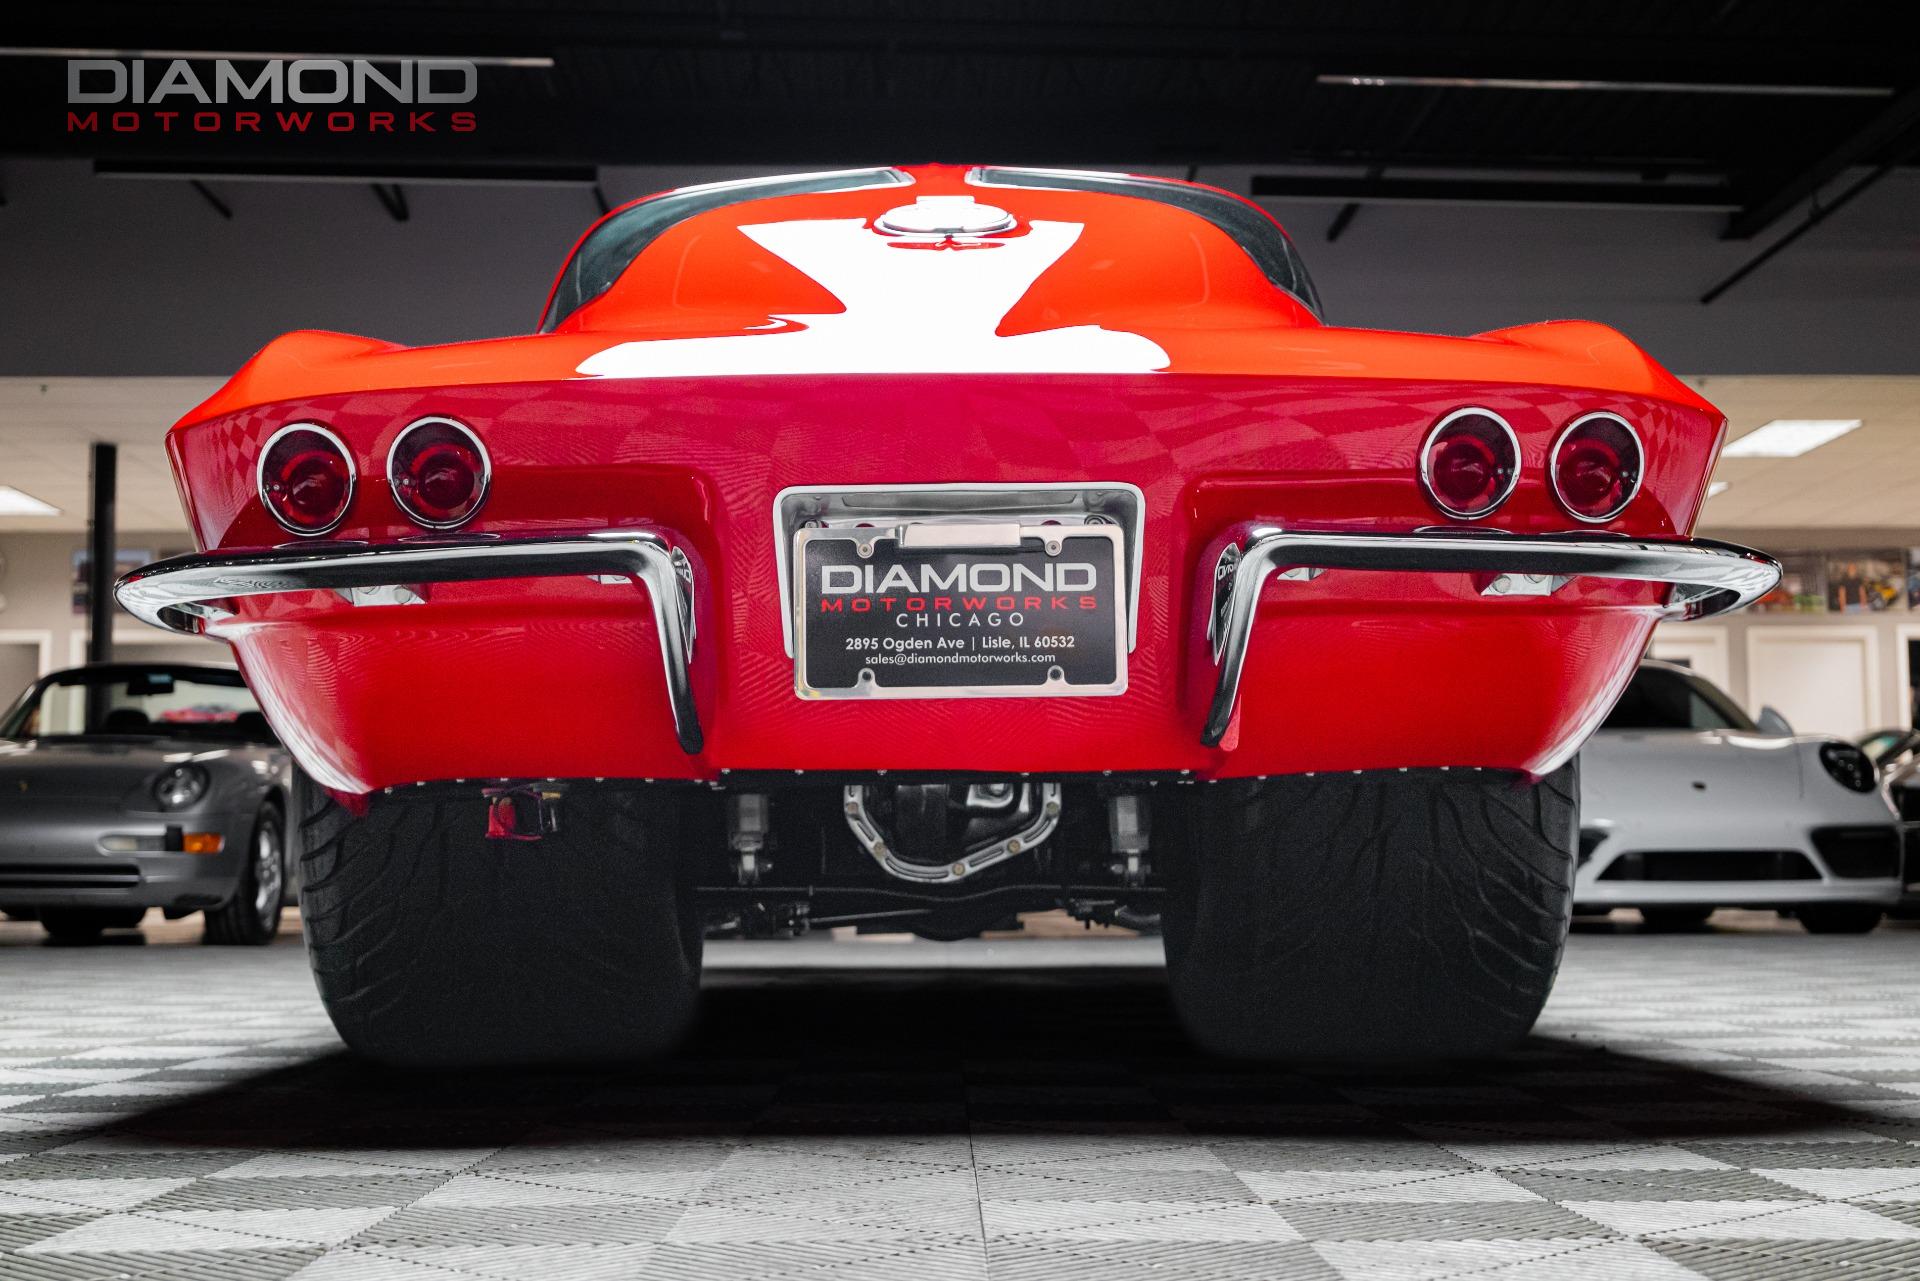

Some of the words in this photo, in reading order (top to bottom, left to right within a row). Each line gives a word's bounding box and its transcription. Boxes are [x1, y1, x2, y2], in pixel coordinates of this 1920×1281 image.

[821, 562, 1097, 595] DIAMOND
[820, 596, 1098, 613] MOTORWORKS
[896, 612, 1025, 628] CHICAGO
[845, 637, 879, 651] 2895
[882, 636, 934, 653] Ogden
[937, 637, 965, 650] Ave
[982, 636, 1016, 651] Lisle,
[1019, 636, 1031, 648] IL
[1034, 635, 1075, 649] 60532
[865, 652, 1056, 666] sales@diamondmotorworks.com
